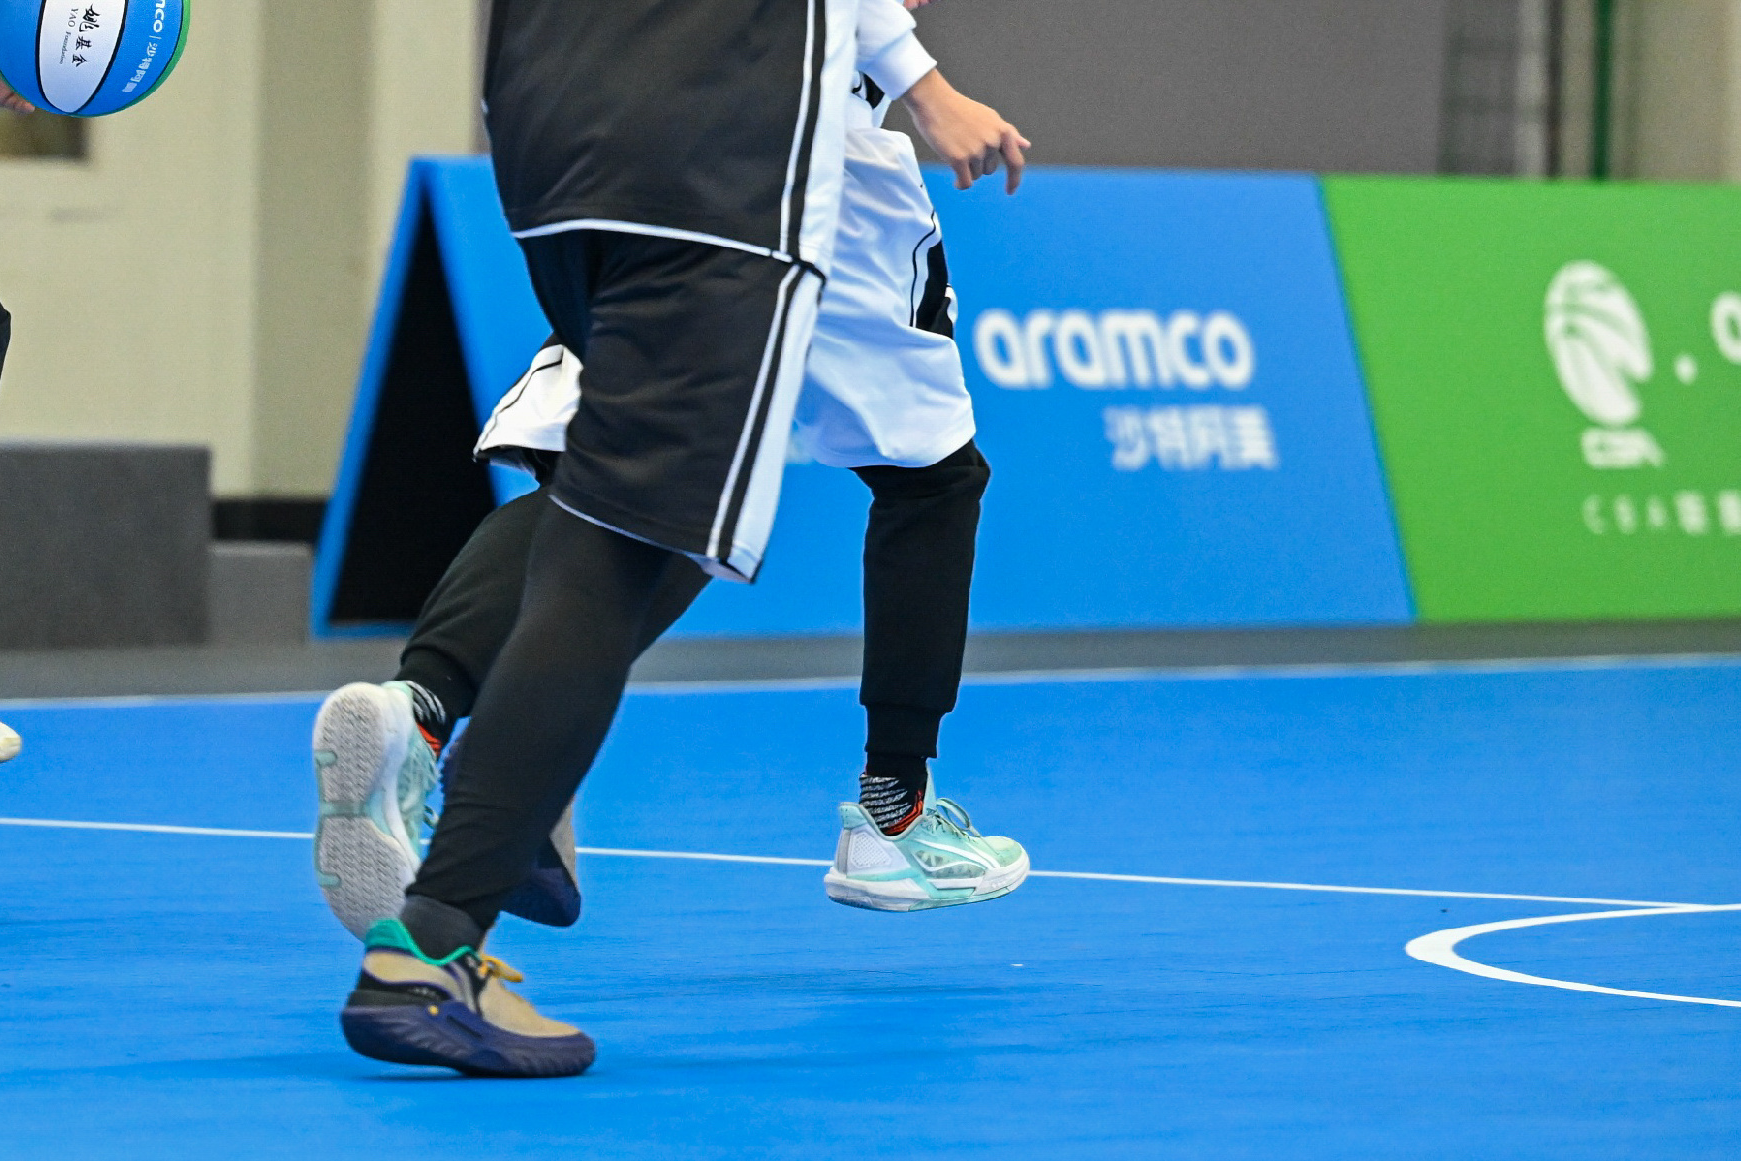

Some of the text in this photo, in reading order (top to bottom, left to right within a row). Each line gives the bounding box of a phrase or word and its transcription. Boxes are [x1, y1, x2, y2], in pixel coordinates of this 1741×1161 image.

[67, 8, 79, 28] YAO
[72, 3, 101, 67] 姚基金
[973, 308, 1255, 391] aramco
